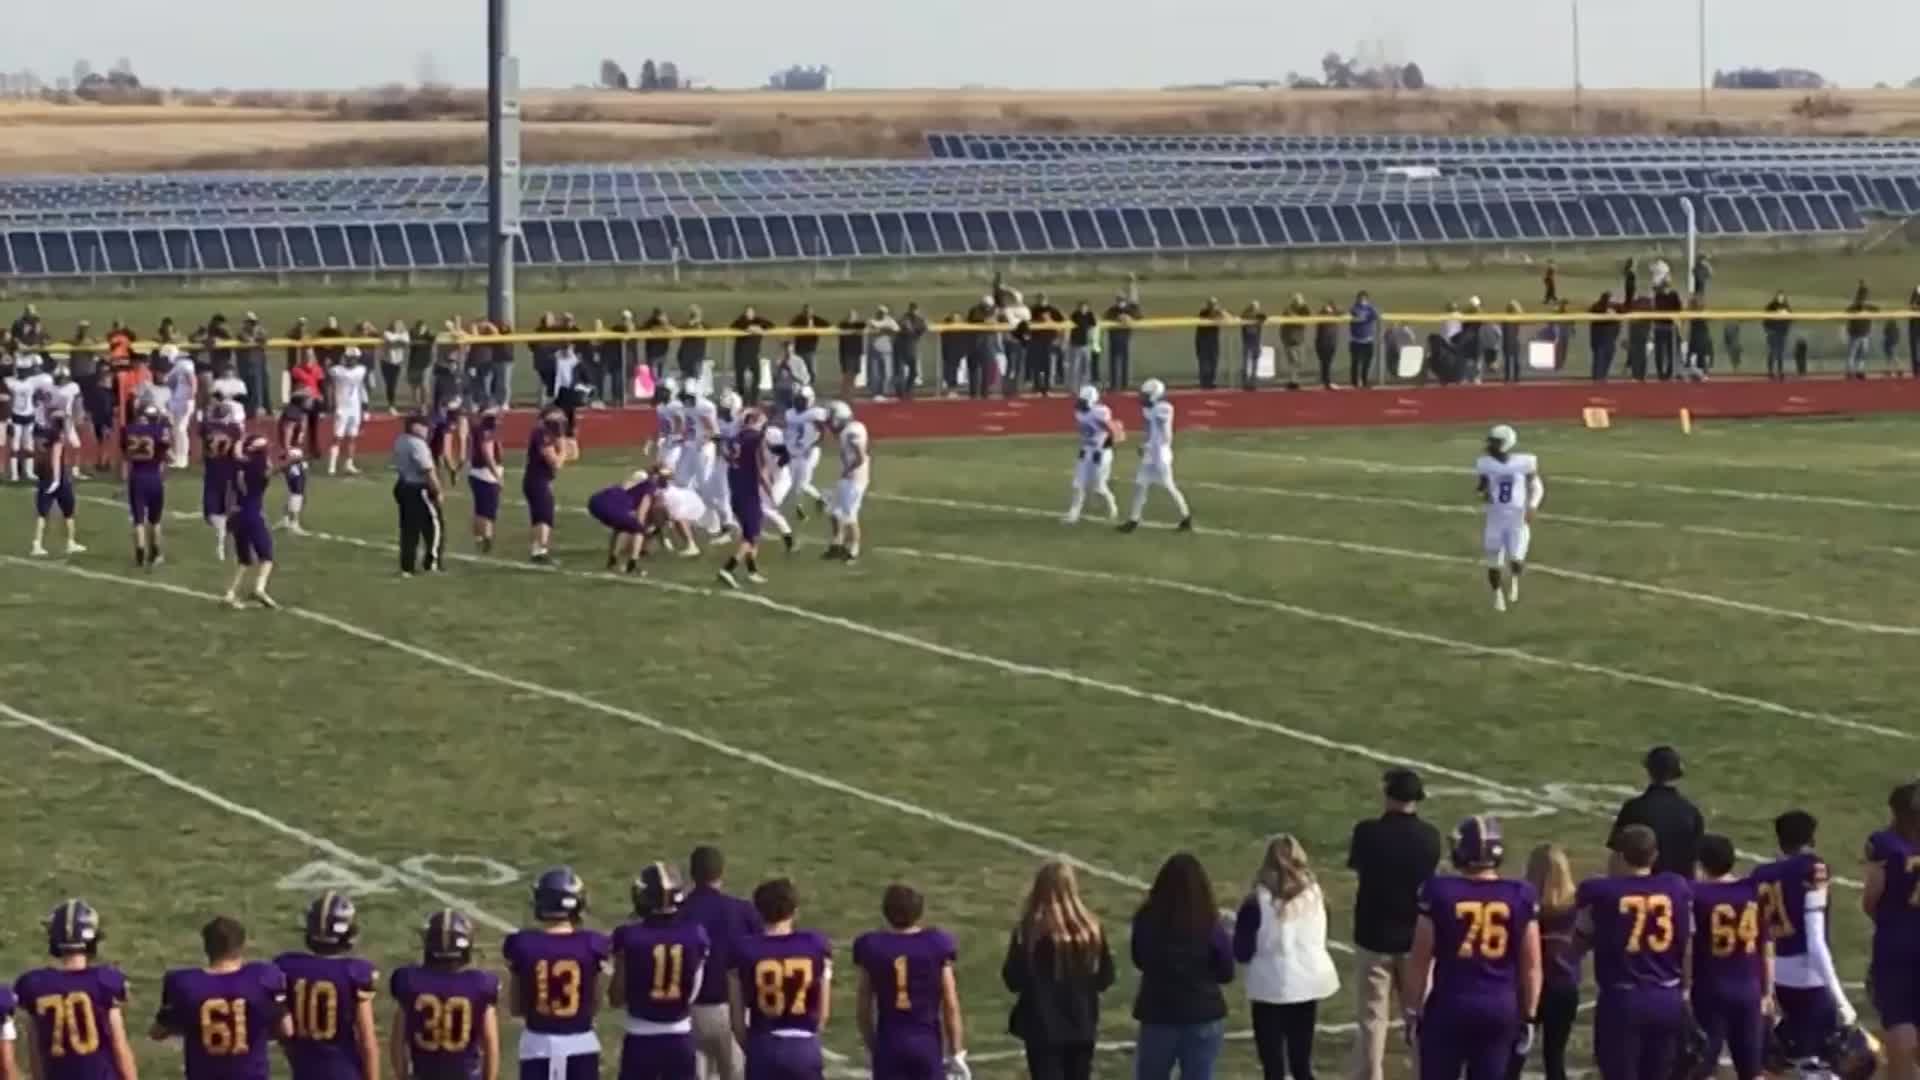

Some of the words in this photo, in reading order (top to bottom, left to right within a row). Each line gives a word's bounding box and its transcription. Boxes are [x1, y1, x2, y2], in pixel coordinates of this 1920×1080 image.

[1499, 474, 1514, 504] 8
[1455, 901, 1511, 959] 76
[1618, 894, 1674, 953] 73
[1710, 901, 1759, 957] 64
[534, 959, 581, 1018] 13
[649, 943, 684, 999] 11
[755, 957, 814, 1018] 87
[893, 955, 911, 1009] 1
[35, 992, 99, 1056] 70
[201, 998, 249, 1055] 61
[294, 977, 338, 1041] 10
[416, 994, 473, 1053] 30
